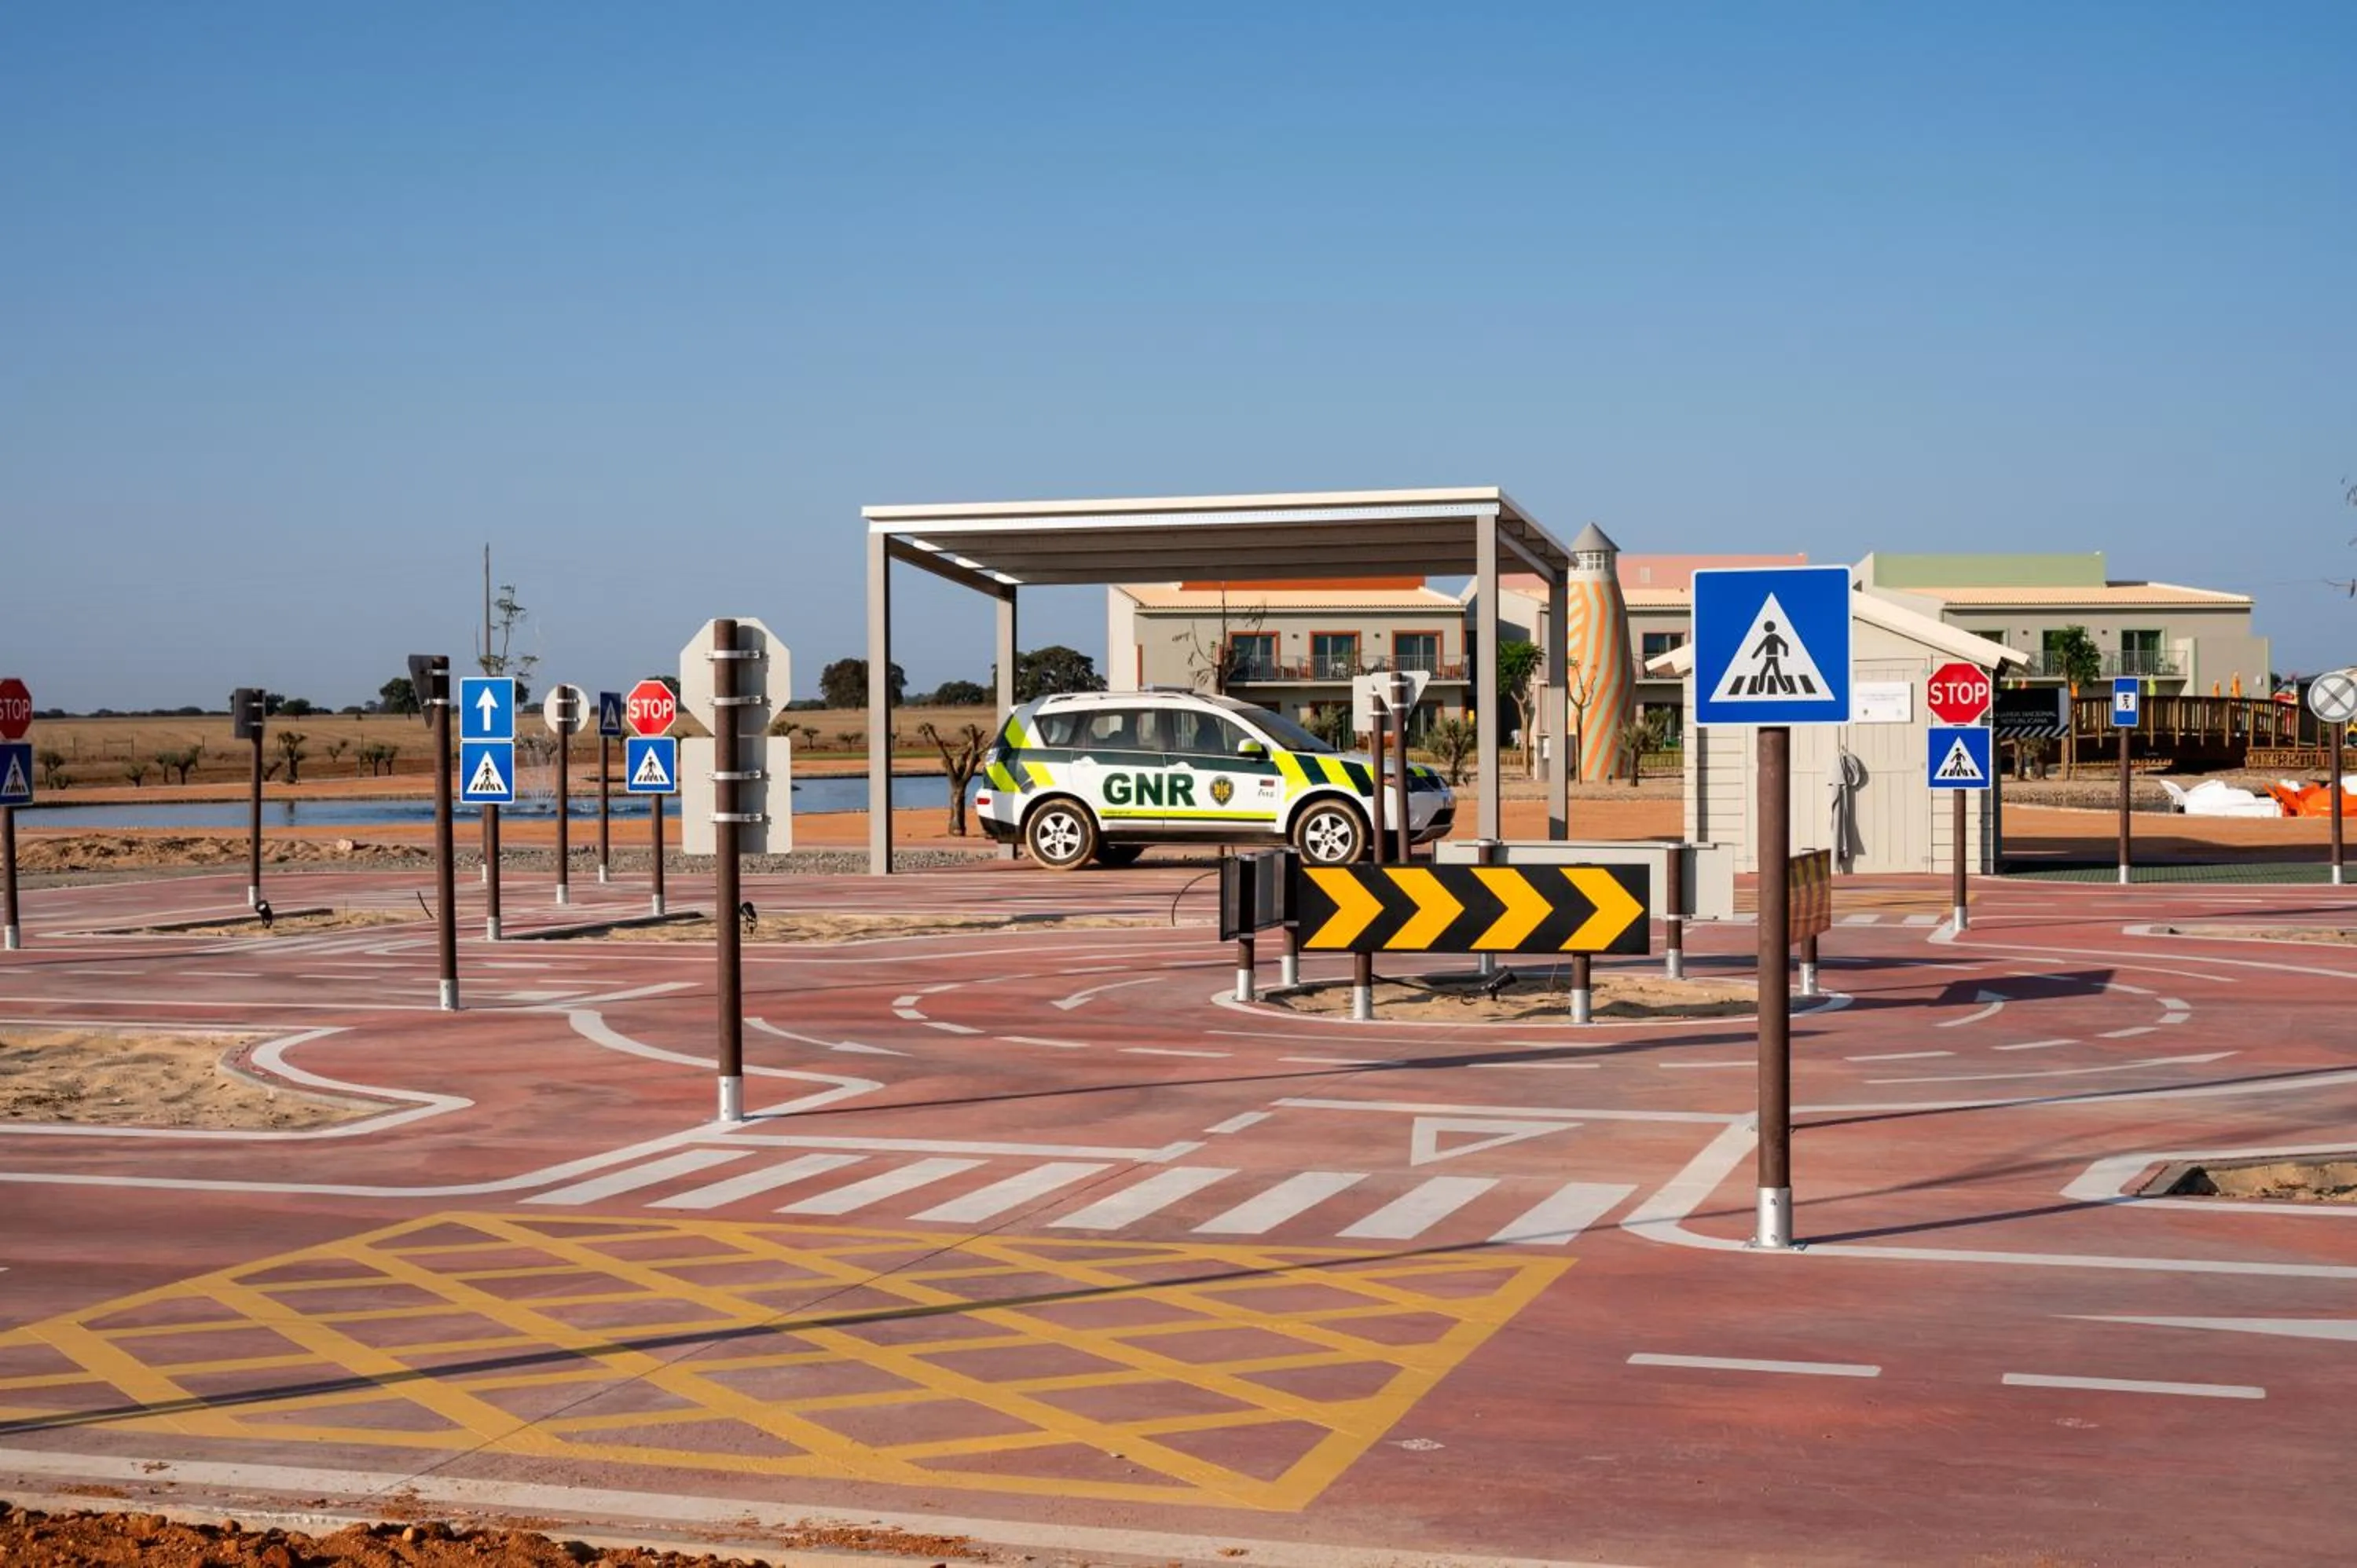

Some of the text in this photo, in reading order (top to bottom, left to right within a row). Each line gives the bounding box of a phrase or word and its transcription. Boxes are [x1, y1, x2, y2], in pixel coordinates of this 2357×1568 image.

[1929, 681, 1987, 705] STOP
[629, 698, 673, 720] STOP
[1102, 772, 1197, 807] GNR
